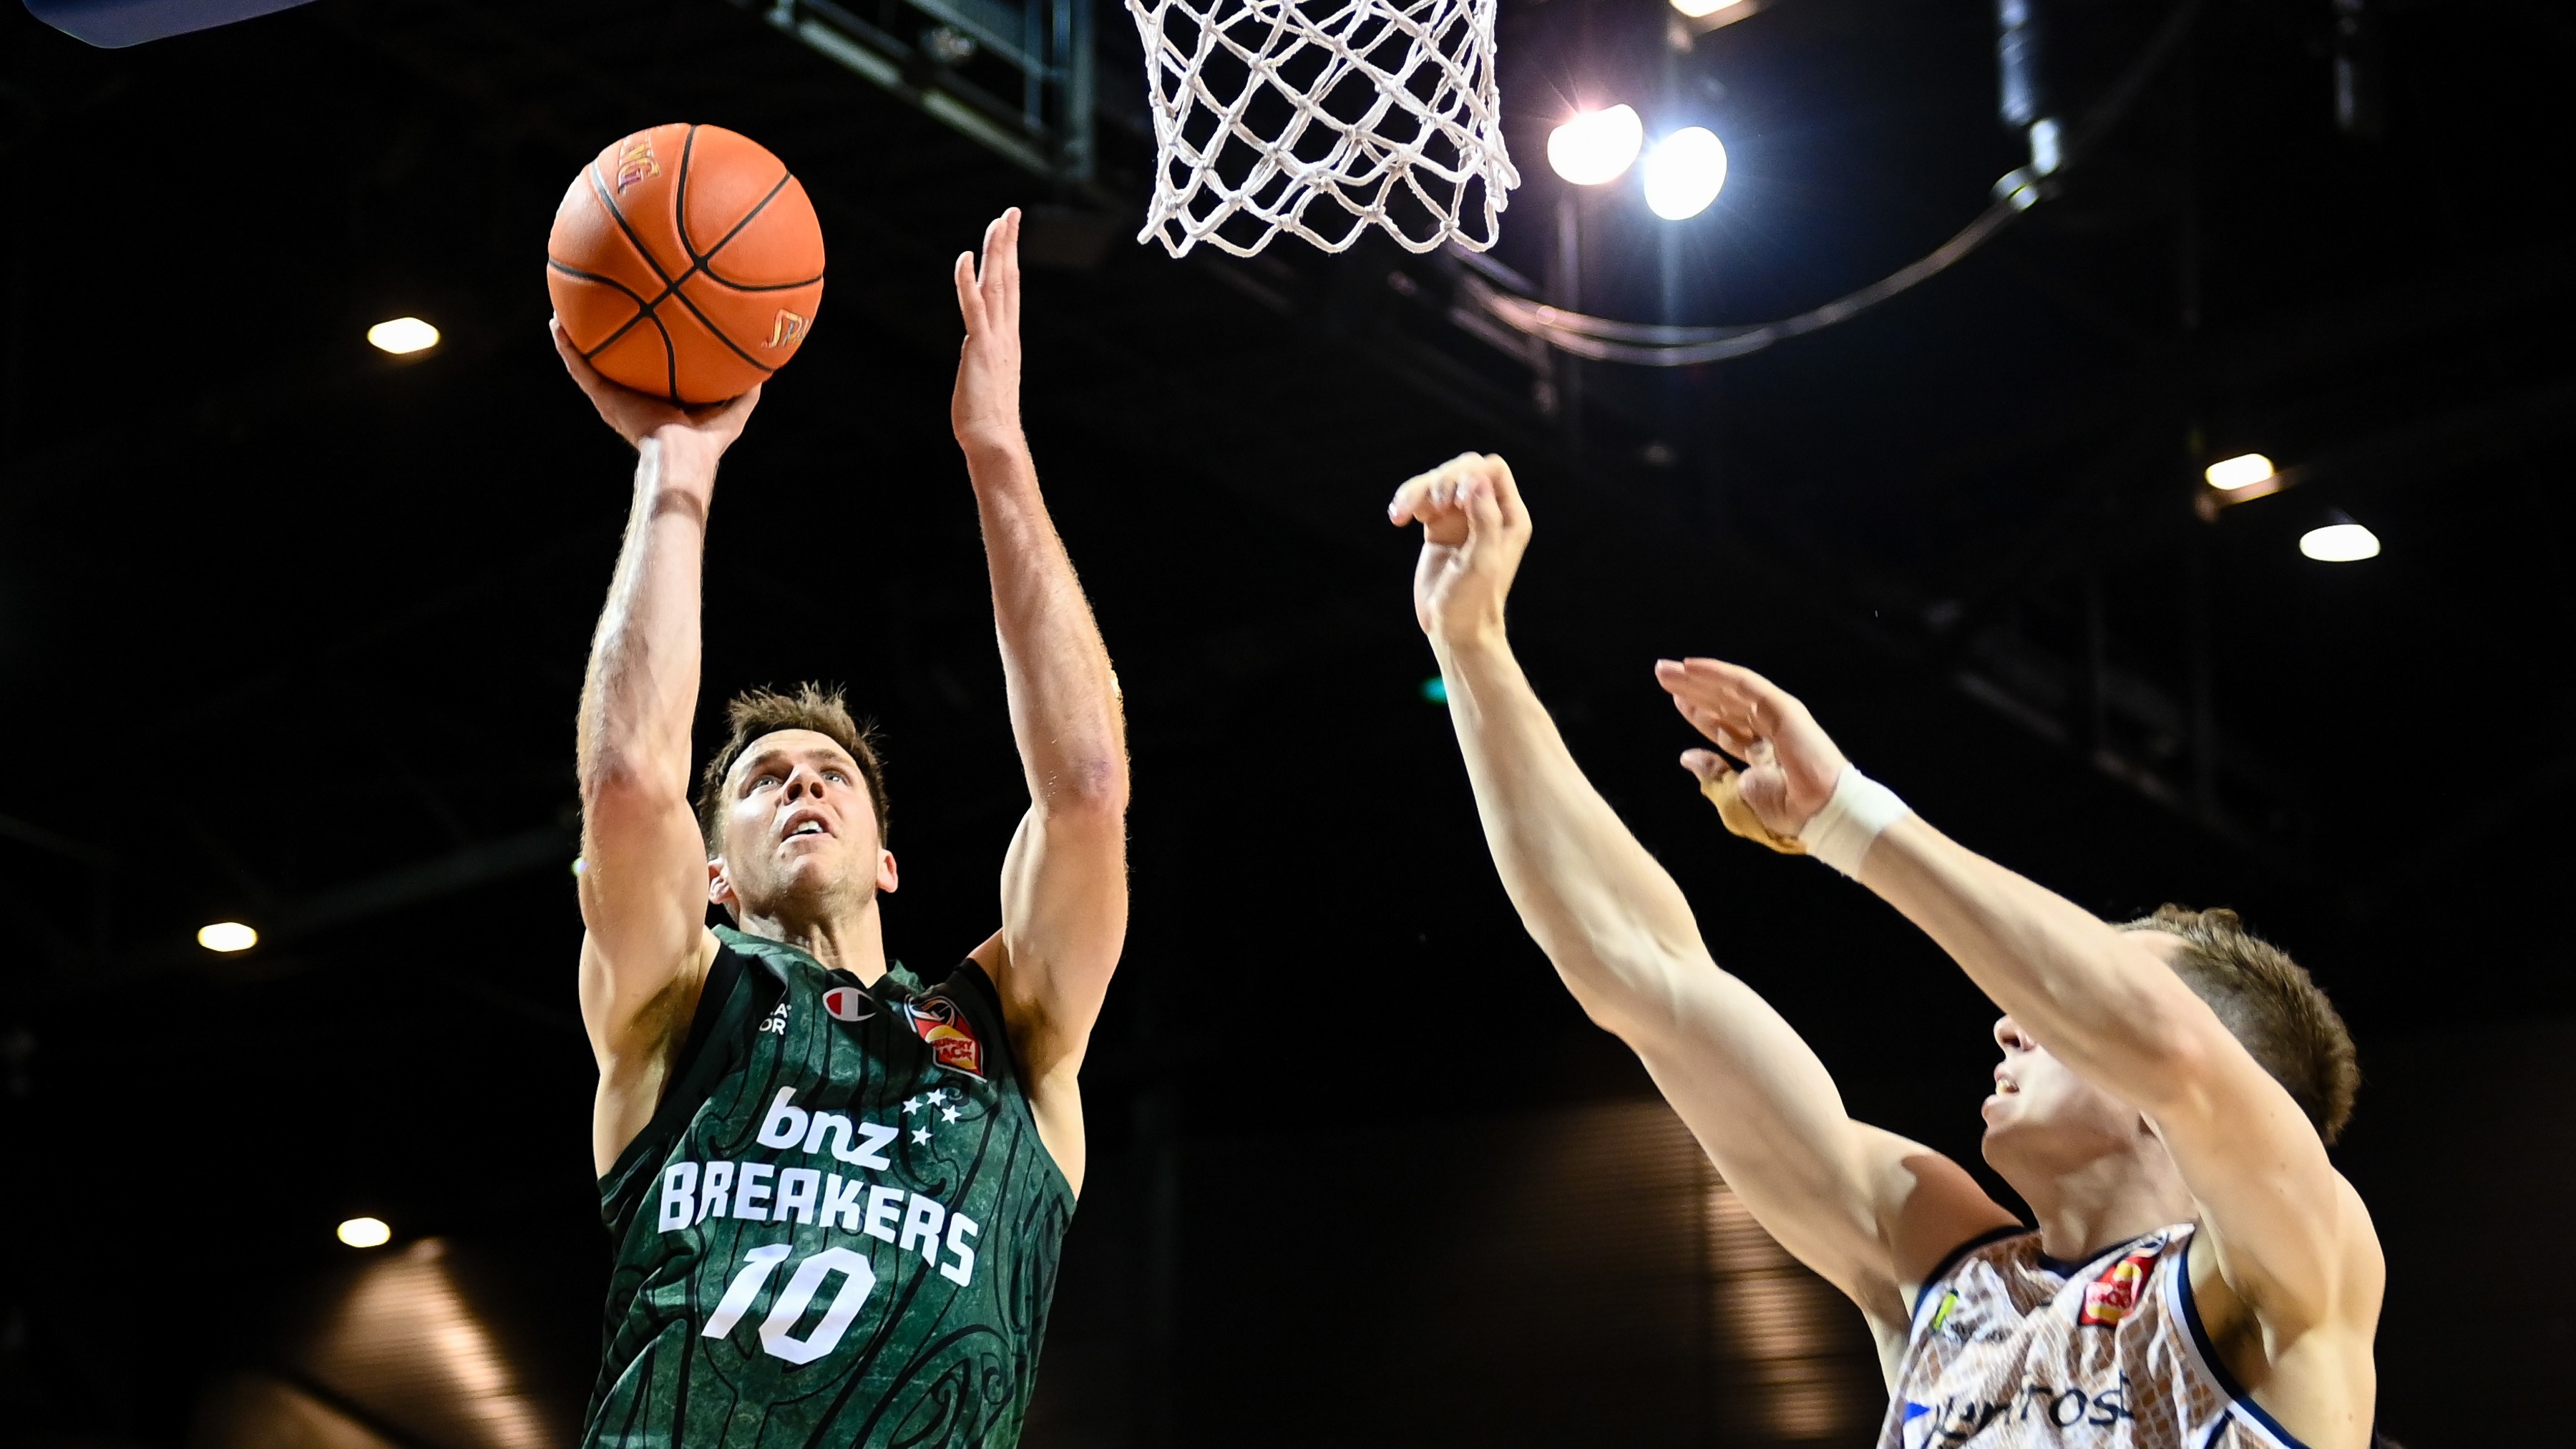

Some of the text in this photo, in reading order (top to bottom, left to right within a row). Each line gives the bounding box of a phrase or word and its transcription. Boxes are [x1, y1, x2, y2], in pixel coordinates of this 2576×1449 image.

[759, 1018, 786, 1035] OR
[756, 1086, 899, 1171] bnz
[658, 1161, 978, 1287] BREAKERS
[701, 1244, 877, 1365] 10
